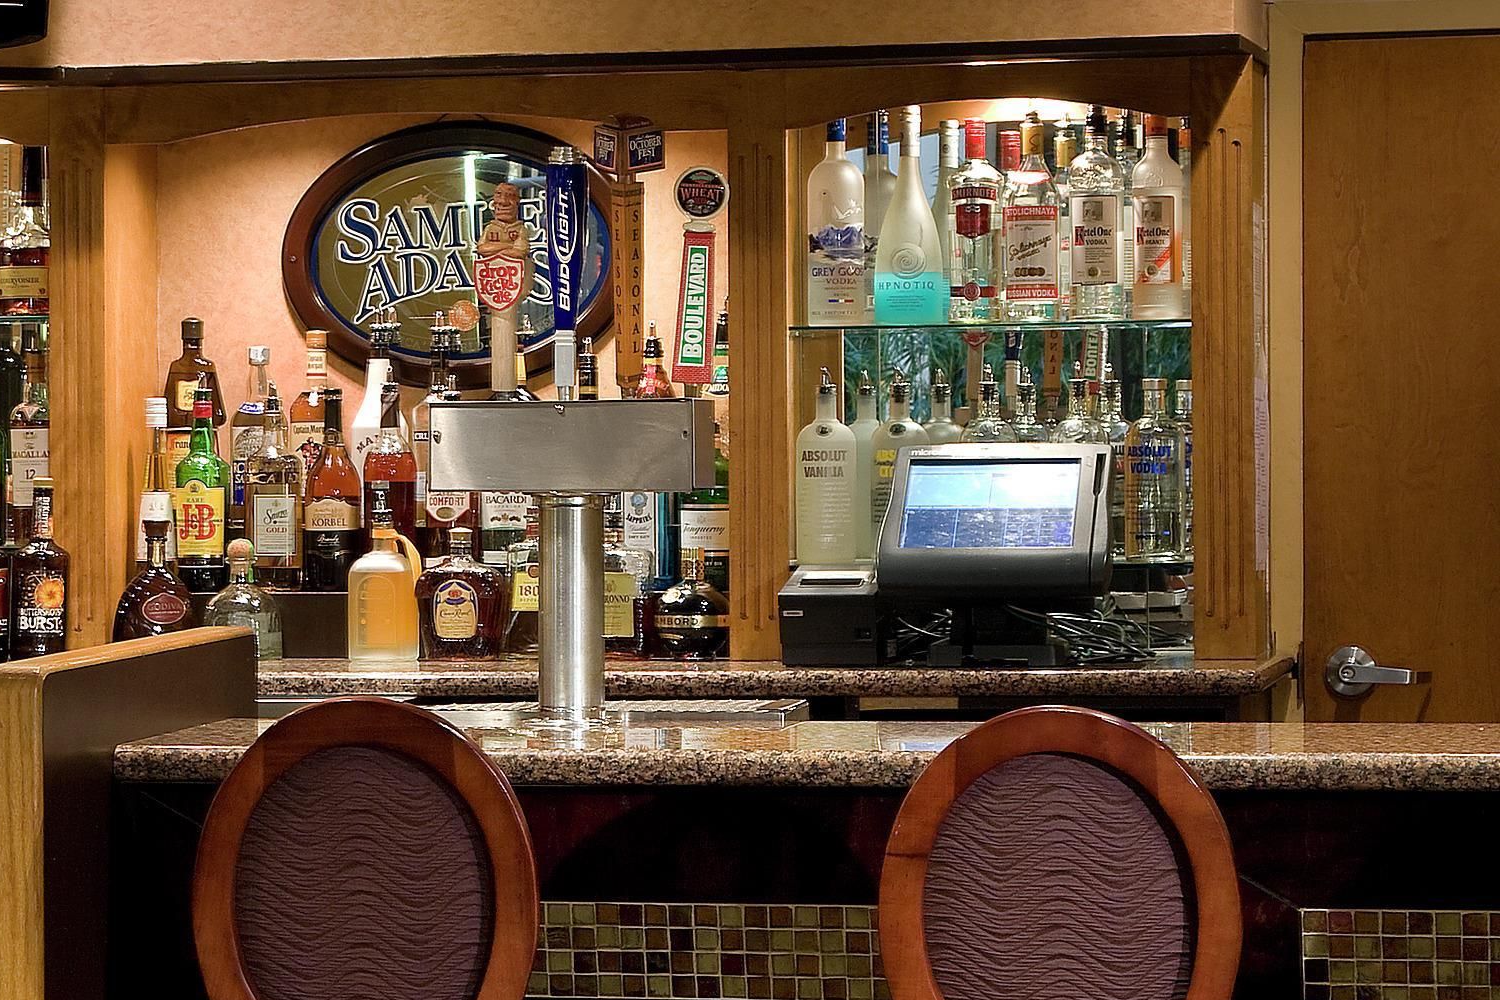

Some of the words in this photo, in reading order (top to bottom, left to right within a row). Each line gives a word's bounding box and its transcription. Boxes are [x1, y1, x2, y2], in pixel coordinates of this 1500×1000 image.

[629, 135, 662, 150] OCTOBER
[638, 147, 655, 160] FEST
[680, 187, 723, 201] WHEAT
[1006, 207, 1055, 217] STOLICHNAYA
[559, 187, 569, 253] LIGHT
[338, 198, 548, 263] SAMUE
[1075, 226, 1096, 246] Ketel
[1097, 226, 1112, 237] One
[1136, 226, 1155, 245] Ketel
[479, 262, 518, 287] drop
[812, 267, 835, 277] GREY
[354, 247, 557, 325] ADAS
[558, 263, 570, 311] BUD
[631, 209, 641, 354] SEASONAL
[879, 281, 935, 290] HPNOTIQ
[1033, 288, 1056, 297] VODKA
[681, 252, 706, 358] BOULEVARD
[801, 450, 847, 461] ABSOLUT
[1128, 446, 1172, 457] ABSOLUT
[26, 469, 37, 480] 12
[1130, 462, 1167, 474] VODKA
[429, 497, 465, 507] COMFORT
[485, 495, 528, 504] BACARDI
[311, 517, 348, 527] KORBEL
